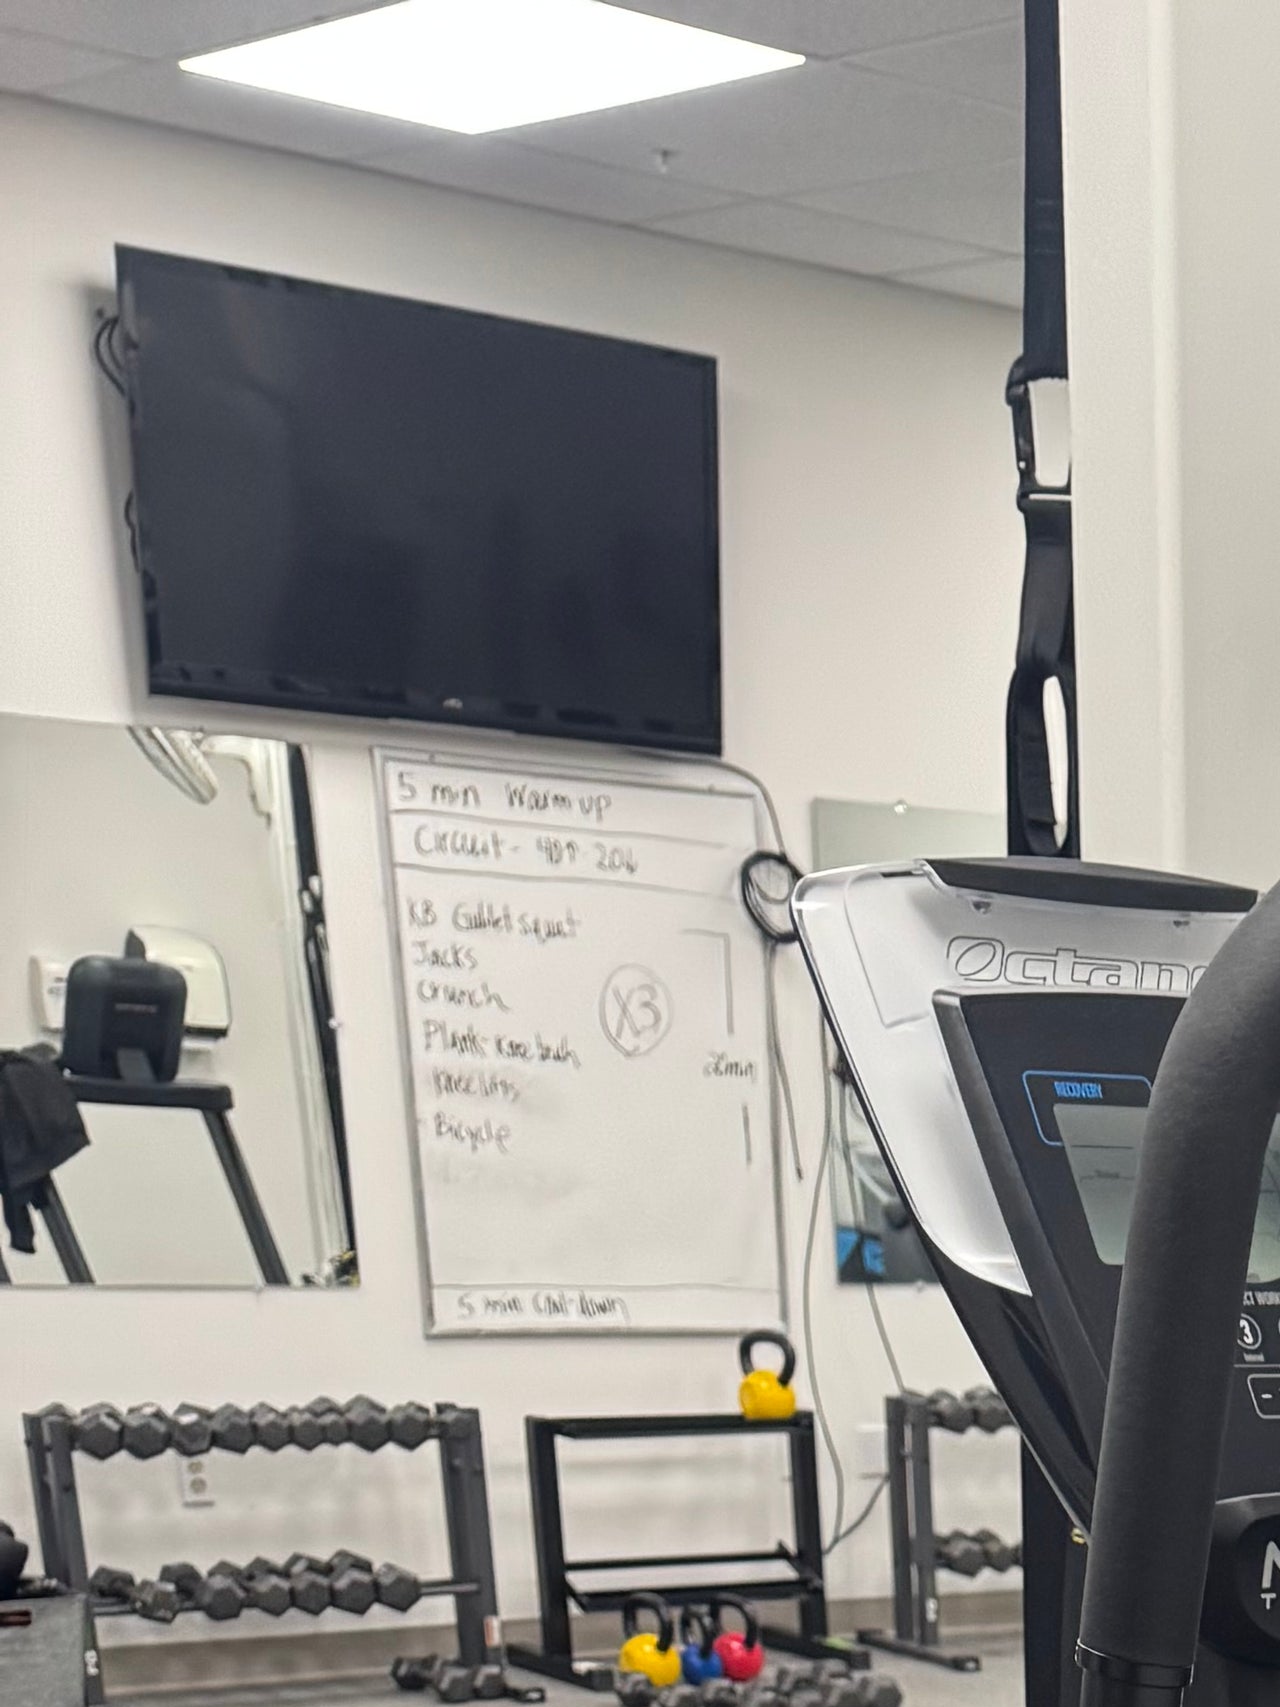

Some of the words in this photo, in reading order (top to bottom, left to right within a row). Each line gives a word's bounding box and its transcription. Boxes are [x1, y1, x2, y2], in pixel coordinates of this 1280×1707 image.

[397, 771, 417, 801] 5
[430, 783, 481, 807] min
[406, 896, 437, 928] KB
[946, 935, 1208, 991] Octan
[1053, 1080, 1104, 1100] RECOVERY
[1239, 1318, 1254, 1344] 3
